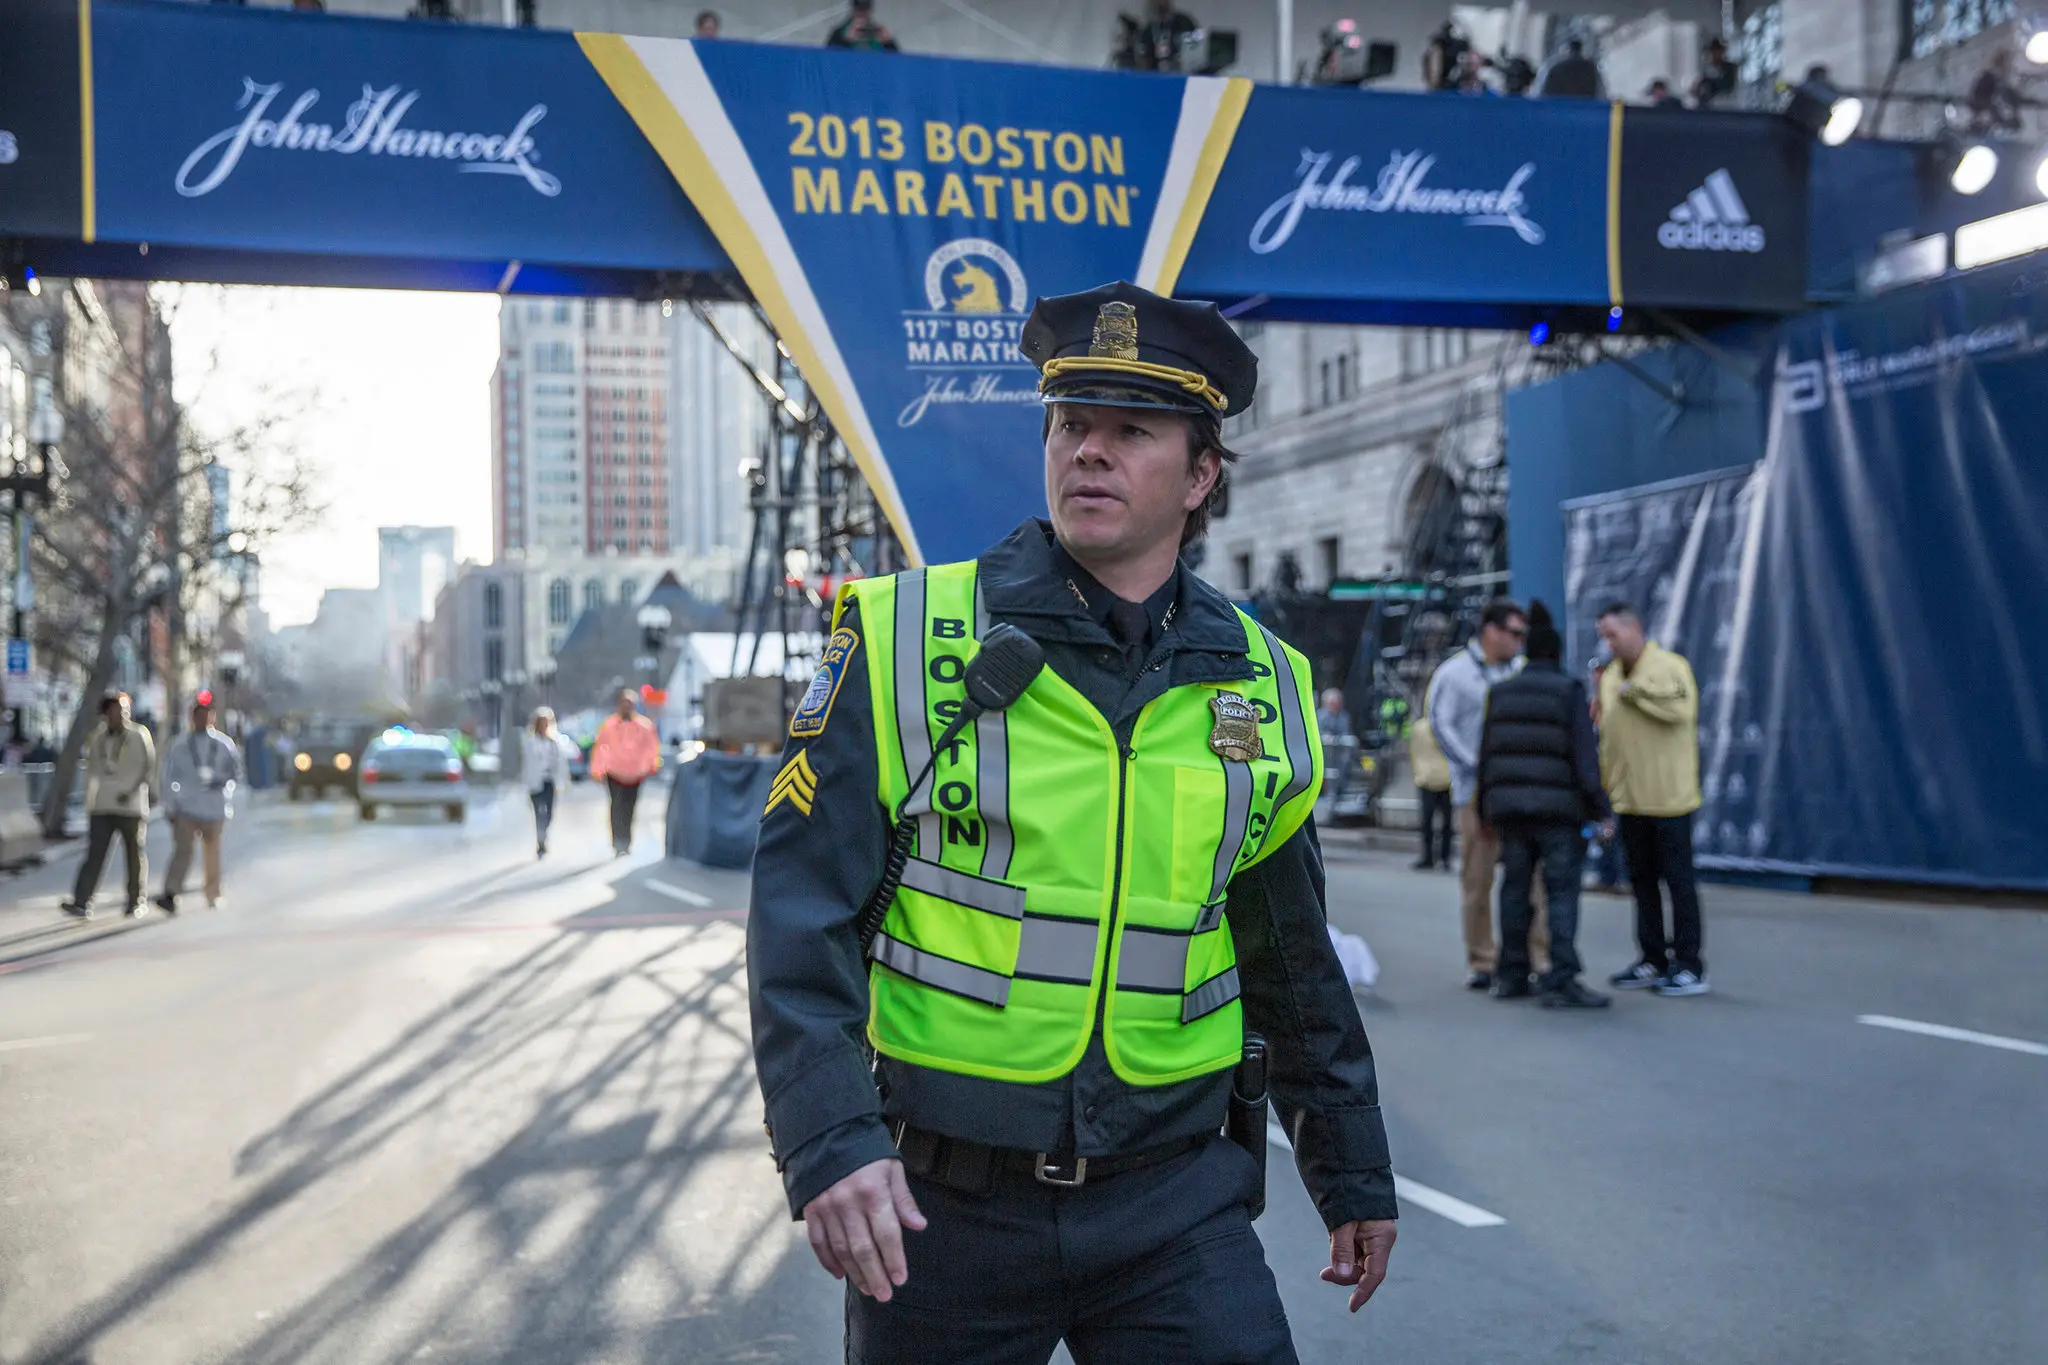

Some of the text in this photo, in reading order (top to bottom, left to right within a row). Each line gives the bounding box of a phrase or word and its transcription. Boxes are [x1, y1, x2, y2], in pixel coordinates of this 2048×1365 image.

[174, 76, 562, 197] John Hancock
[788, 111, 1125, 176] 2013 BOSTON
[791, 167, 1131, 227] MARATHON
[1248, 147, 1546, 254] John Hancock
[1657, 221, 1765, 253] adidas
[908, 341, 1029, 363] MARATH
[956, 320, 1025, 340] BOST
[898, 373, 967, 427] John
[929, 616, 980, 847] BOSTON
[1242, 661, 1280, 859] POLIC
